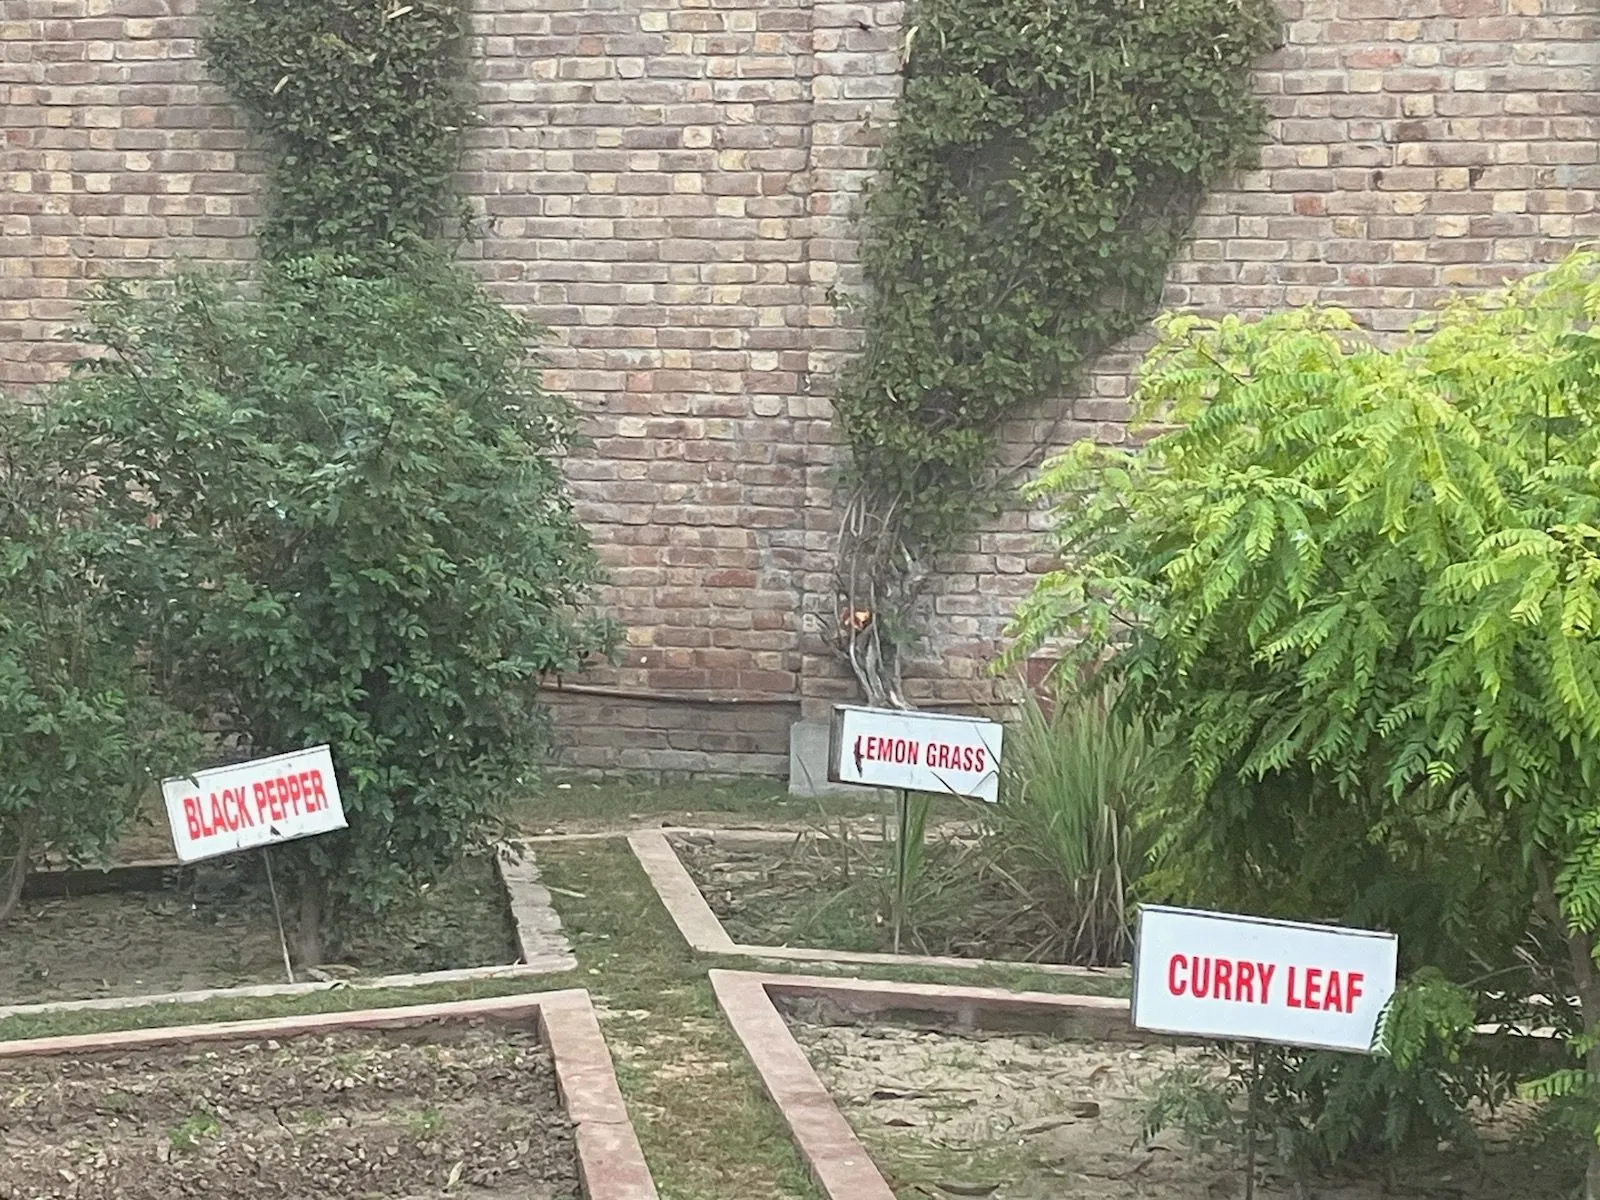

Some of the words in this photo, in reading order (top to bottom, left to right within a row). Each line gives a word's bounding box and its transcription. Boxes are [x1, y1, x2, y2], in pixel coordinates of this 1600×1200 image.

[856, 735, 919, 765] LEMON
[926, 743, 985, 773] GRASS
[183, 786, 254, 840] BLACK
[252, 769, 329, 825] PEPPER
[1167, 953, 1276, 1004] CURRY
[1285, 966, 1364, 1014] LEAF
